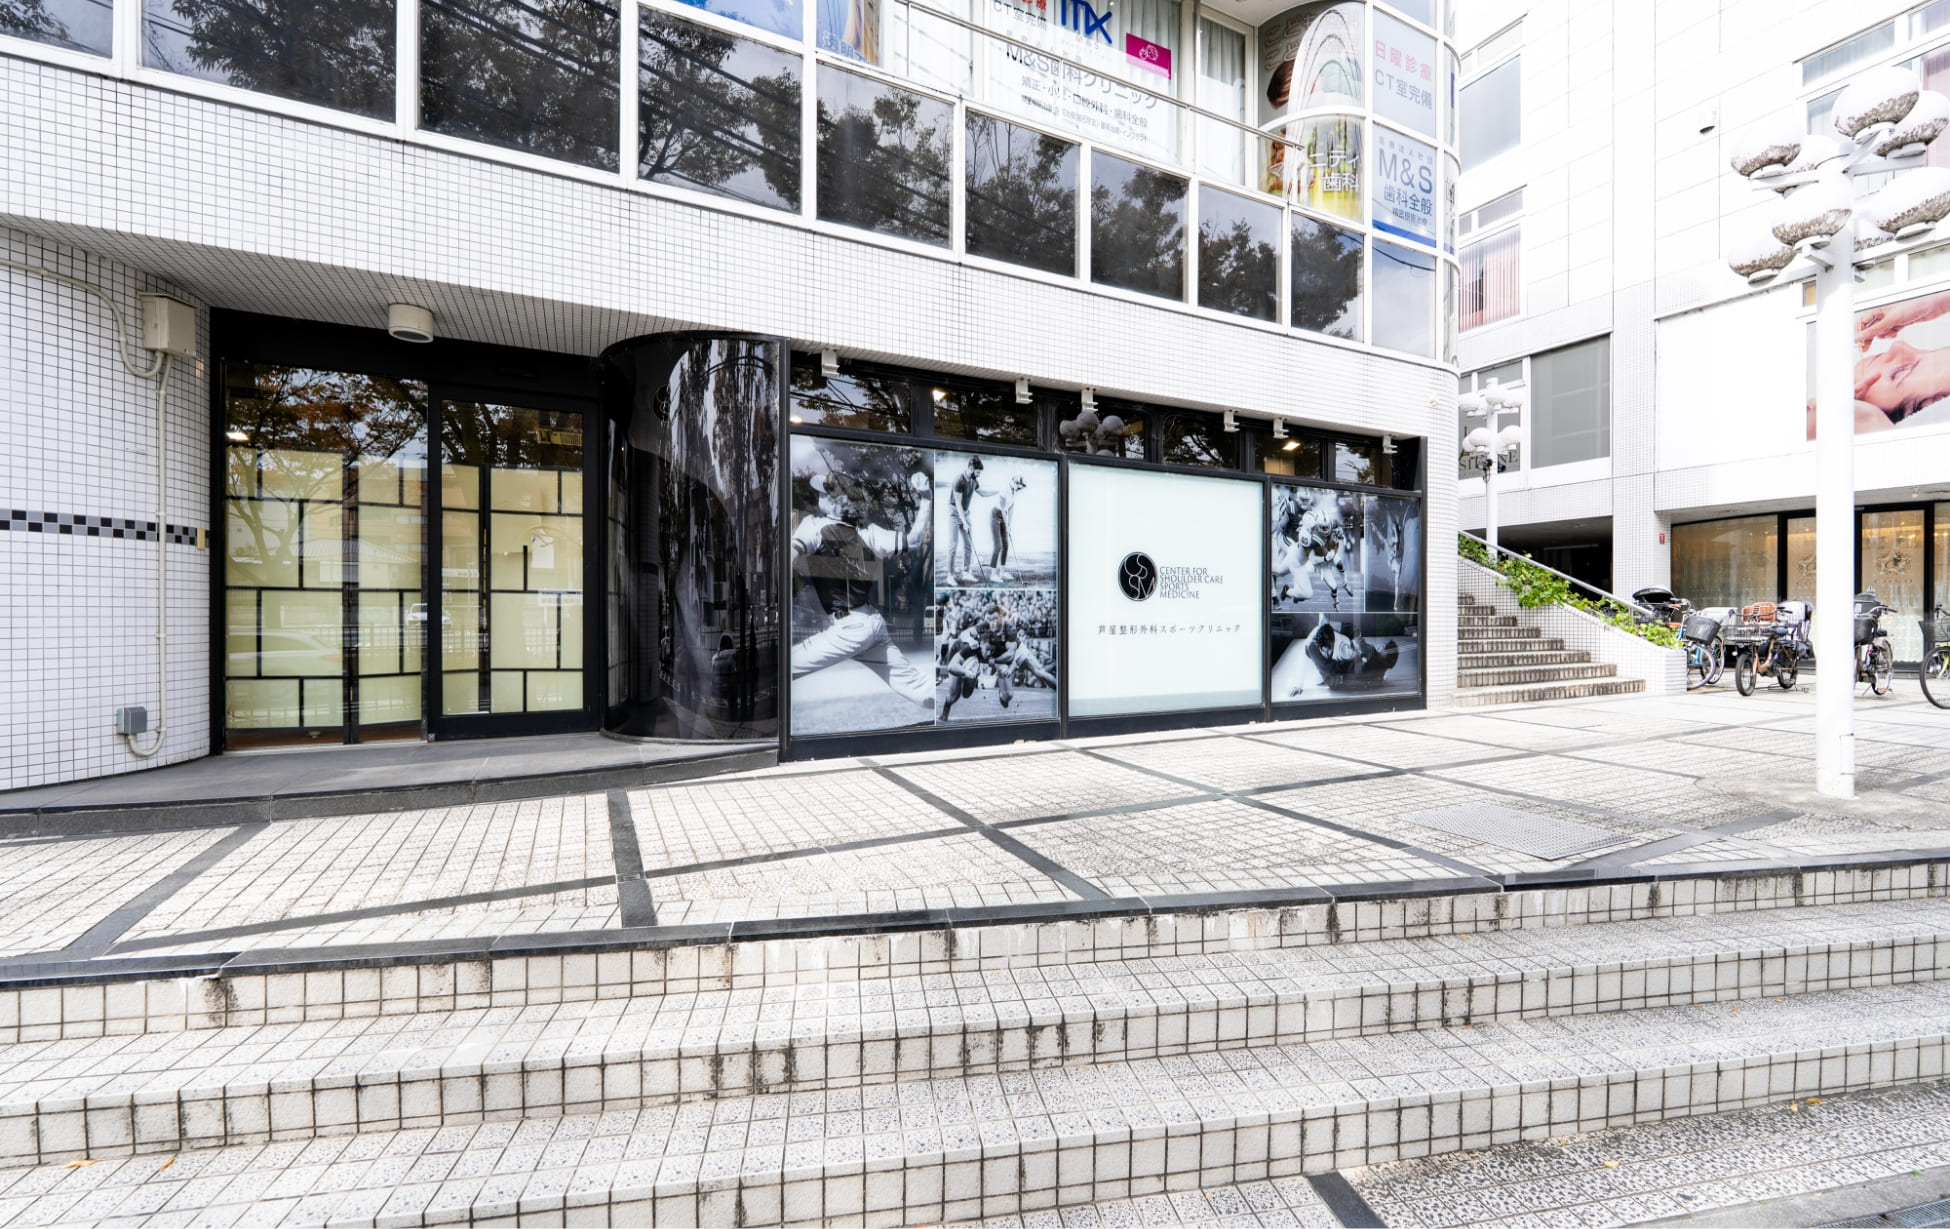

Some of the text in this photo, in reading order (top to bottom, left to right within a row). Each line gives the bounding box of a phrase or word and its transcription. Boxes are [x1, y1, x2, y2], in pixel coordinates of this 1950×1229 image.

[1375, 39, 1432, 81] 日曜診療
[1375, 68, 1432, 110] CT室完備
[1378, 147, 1433, 194] M&S
[1322, 172, 1360, 193] 歯科
[1383, 184, 1433, 216] 歯科全般
[1159, 566, 1208, 576] CENTER FOR
[1159, 574, 1224, 584] SHOULDER CARE
[1159, 582, 1190, 591] SPORTS
[1159, 590, 1201, 599] MEDICINE
[1098, 624, 1240, 635] 芦屋整形外科スポーツクリニック
